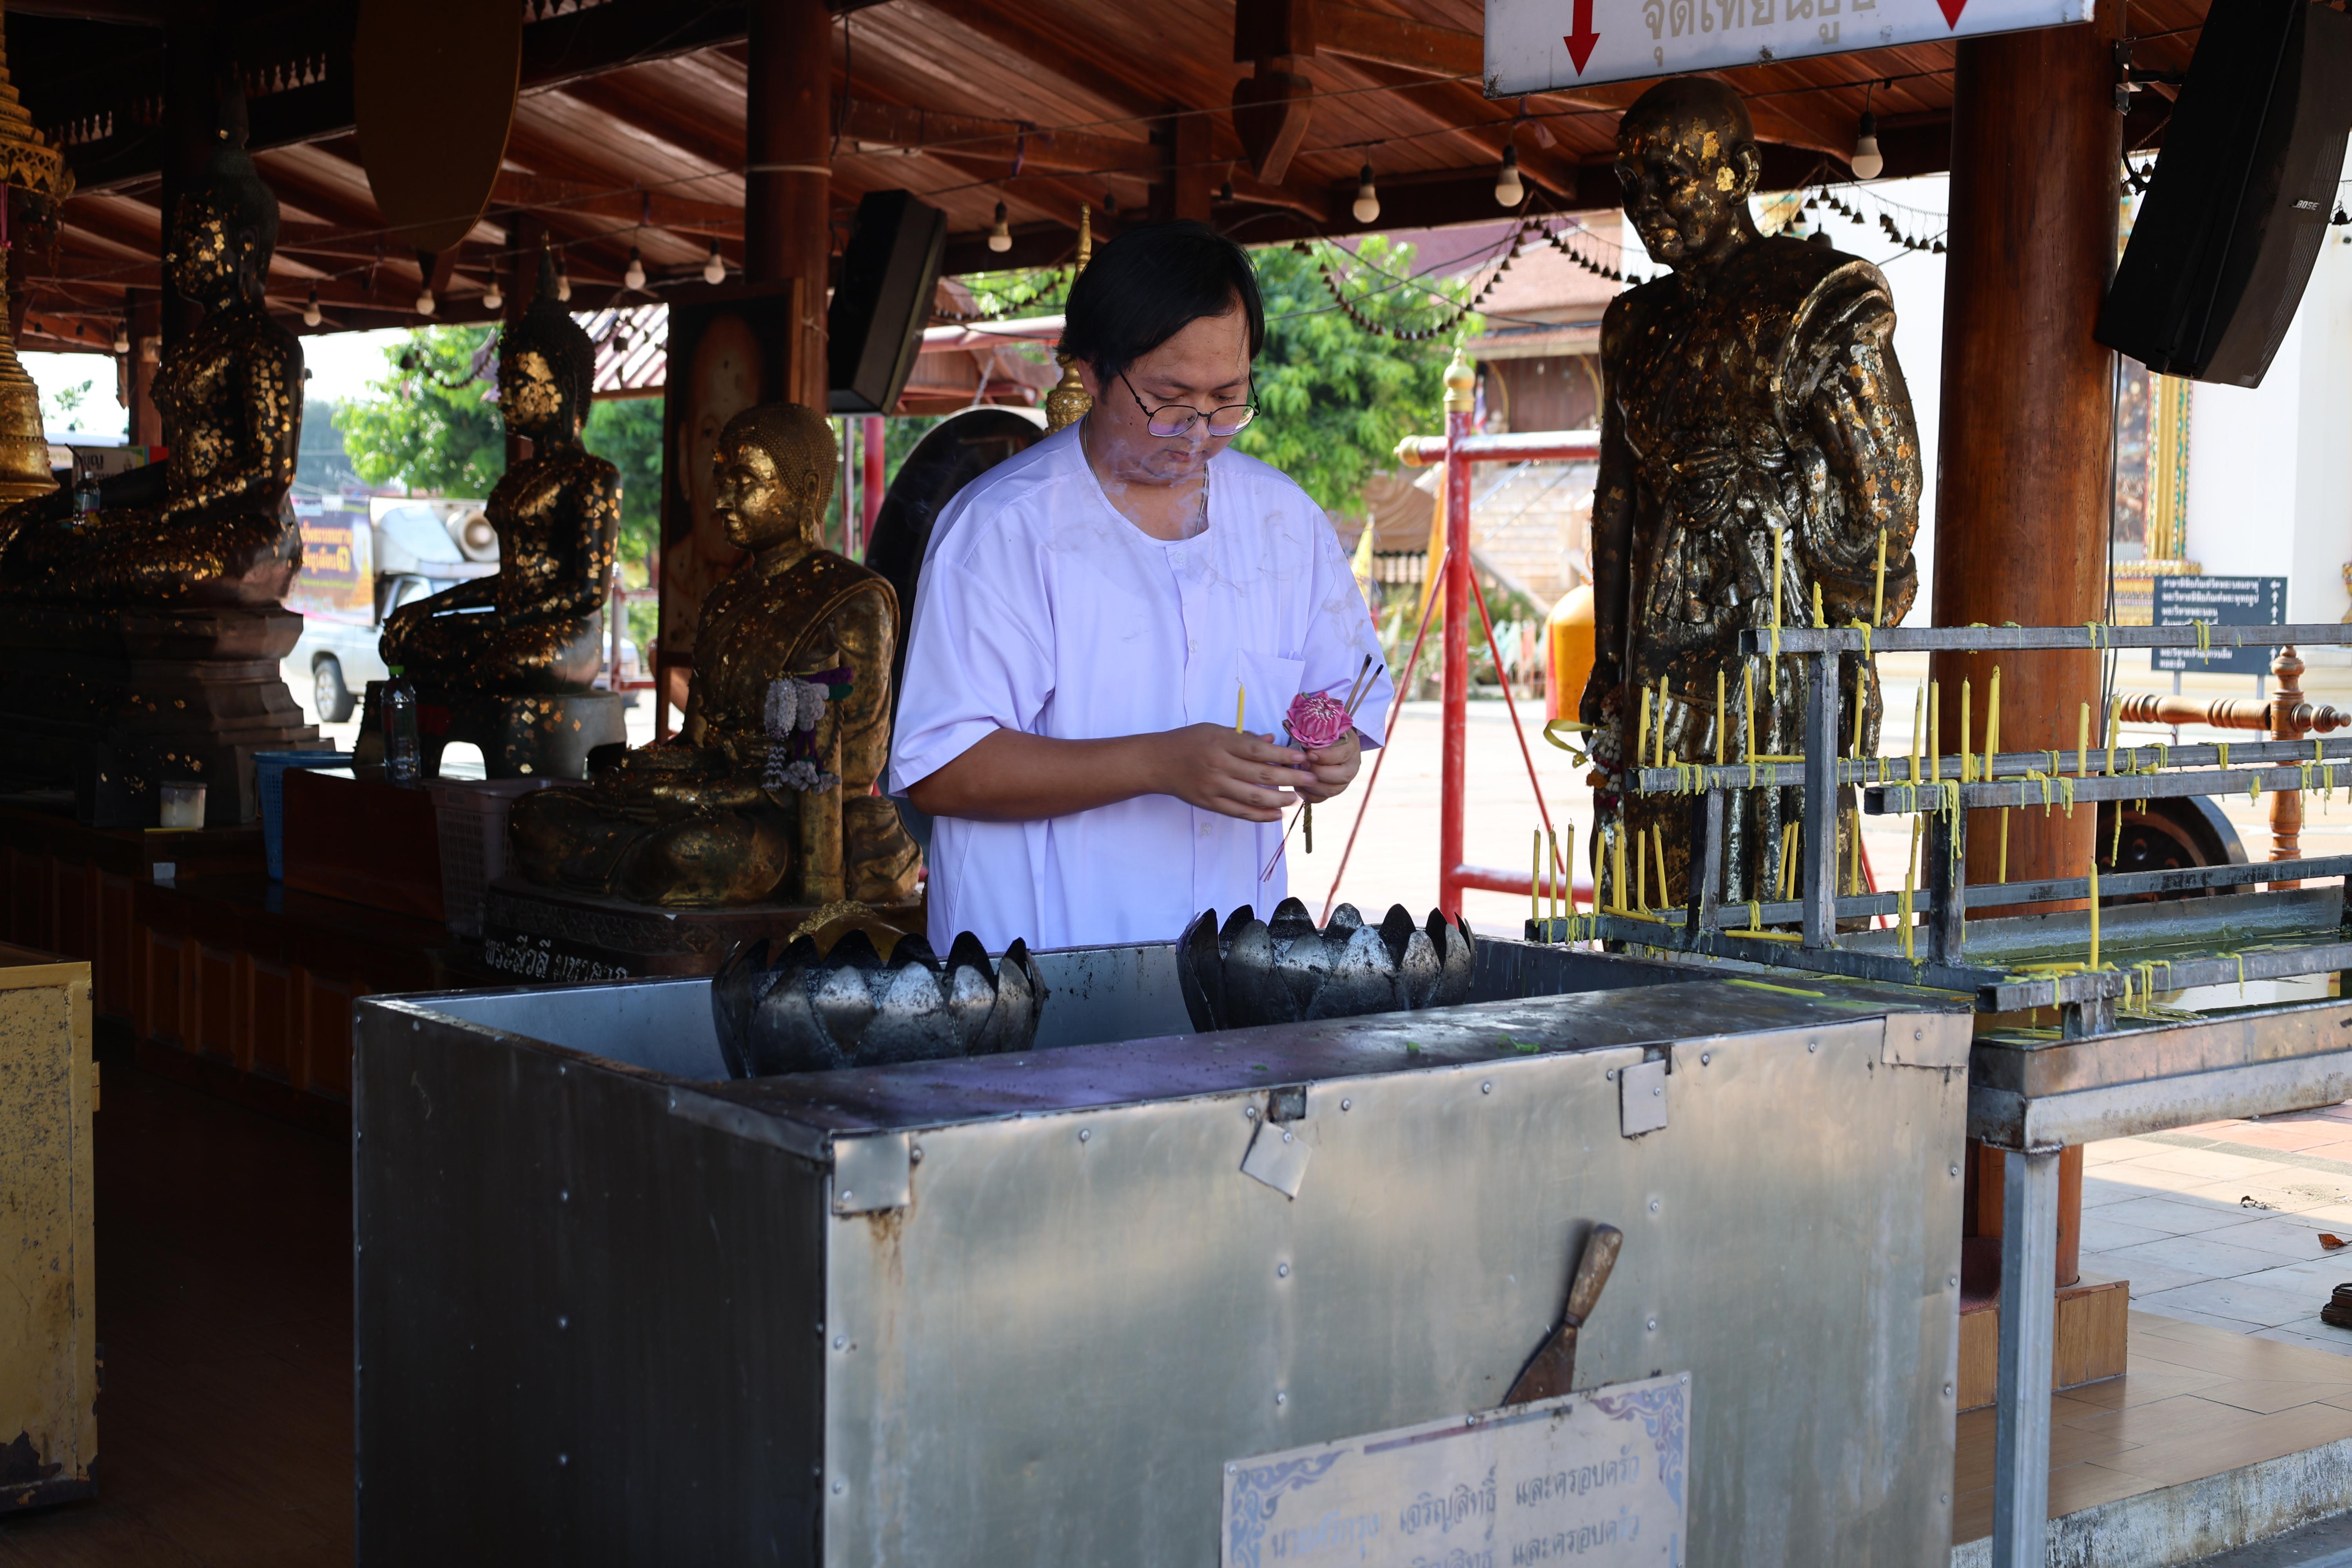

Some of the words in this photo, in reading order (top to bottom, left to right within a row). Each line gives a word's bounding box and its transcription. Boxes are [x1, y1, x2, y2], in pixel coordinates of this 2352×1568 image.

[1642, 0, 1876, 67] จุดเทยนู
[2296, 200, 2319, 211] BOSE
[1400, 1459, 1498, 1535] เจริญสิทธิ์
[1515, 1443, 1640, 1507] และครอบครัว
[1512, 1504, 1640, 1567] และครอบครัว
